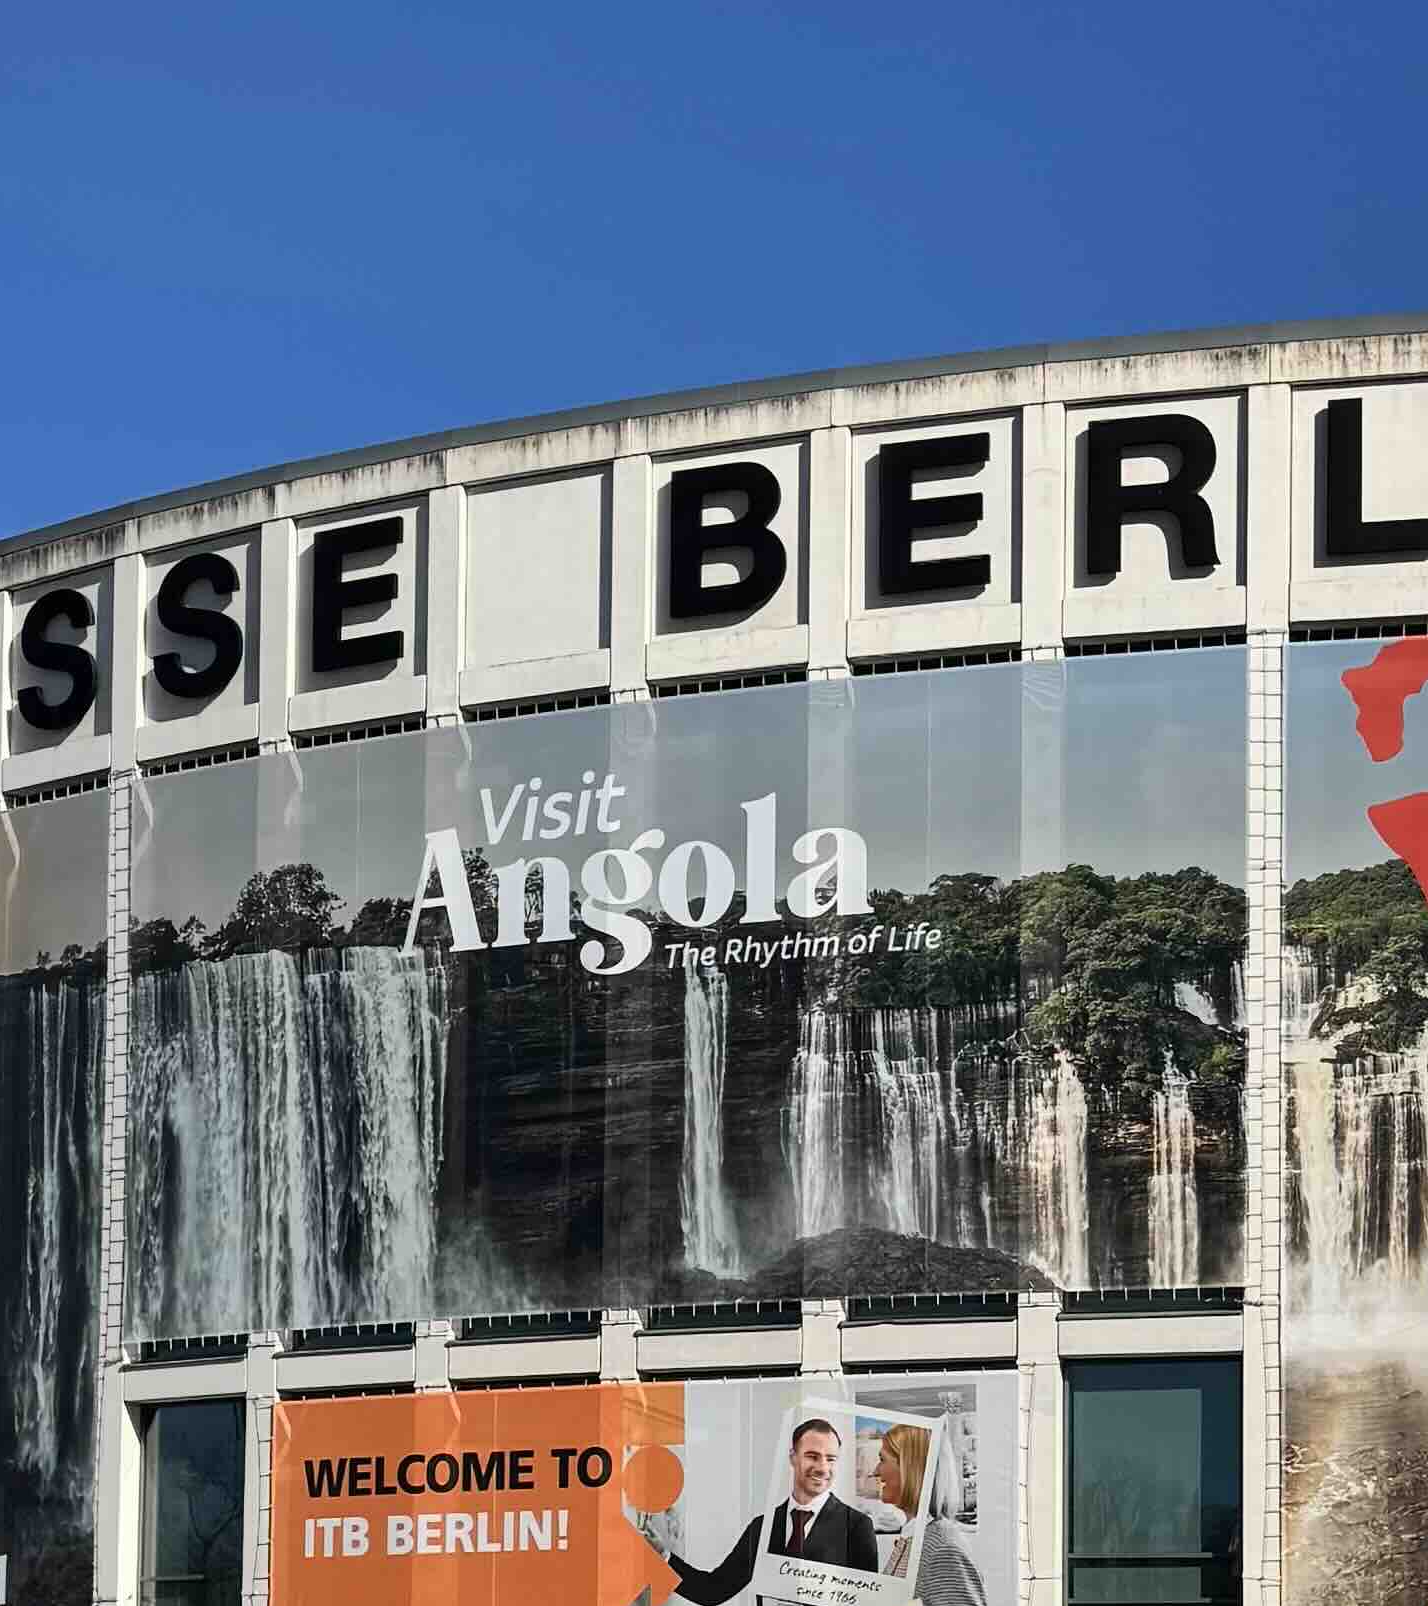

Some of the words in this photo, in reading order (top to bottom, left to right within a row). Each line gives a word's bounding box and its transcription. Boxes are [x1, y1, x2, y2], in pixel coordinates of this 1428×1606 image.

[480, 770, 627, 845] Visit
[399, 792, 874, 976] Angola
[664, 941, 717, 969] The
[724, 932, 841, 968] Rhythm
[847, 924, 883, 955] of
[888, 923, 942, 952] Life
[303, 1450, 535, 1498] WELCOME
[551, 1446, 613, 1489] TO
[304, 1516, 370, 1559] ITB
[387, 1509, 570, 1556] BERLIN!
[779, 1560, 827, 1585] Creating
[830, 1575, 883, 1592] moments
